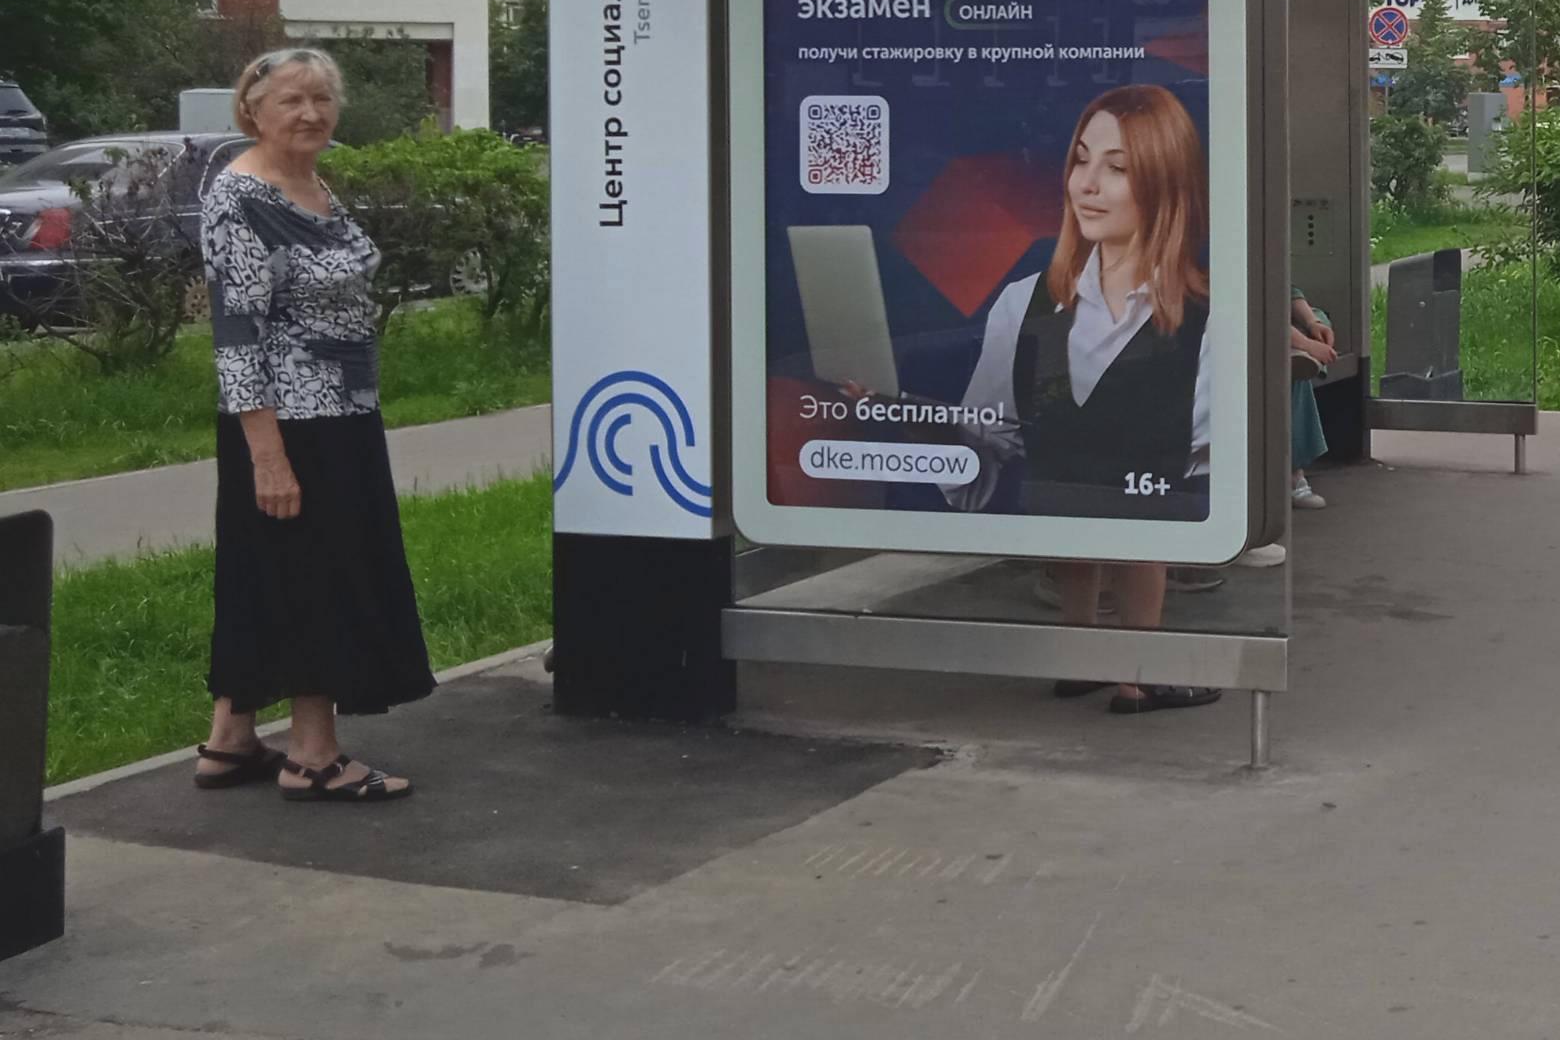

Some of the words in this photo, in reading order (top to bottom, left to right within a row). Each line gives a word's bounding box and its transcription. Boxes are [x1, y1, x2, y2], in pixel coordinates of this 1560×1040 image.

[958, 1, 1034, 21] ОНЛАЙН
[798, 46, 859, 62] получи
[862, 45, 963, 62] стажировку
[969, 46, 979, 59] в
[981, 43, 1054, 63] крупной
[1057, 46, 1145, 61] компании
[599, 116, 629, 227] Центр
[799, 394, 848, 421] Это
[855, 395, 1006, 426] бесплатно!
[809, 446, 969, 476] dke.moscow
[1123, 472, 1171, 496] 16+
